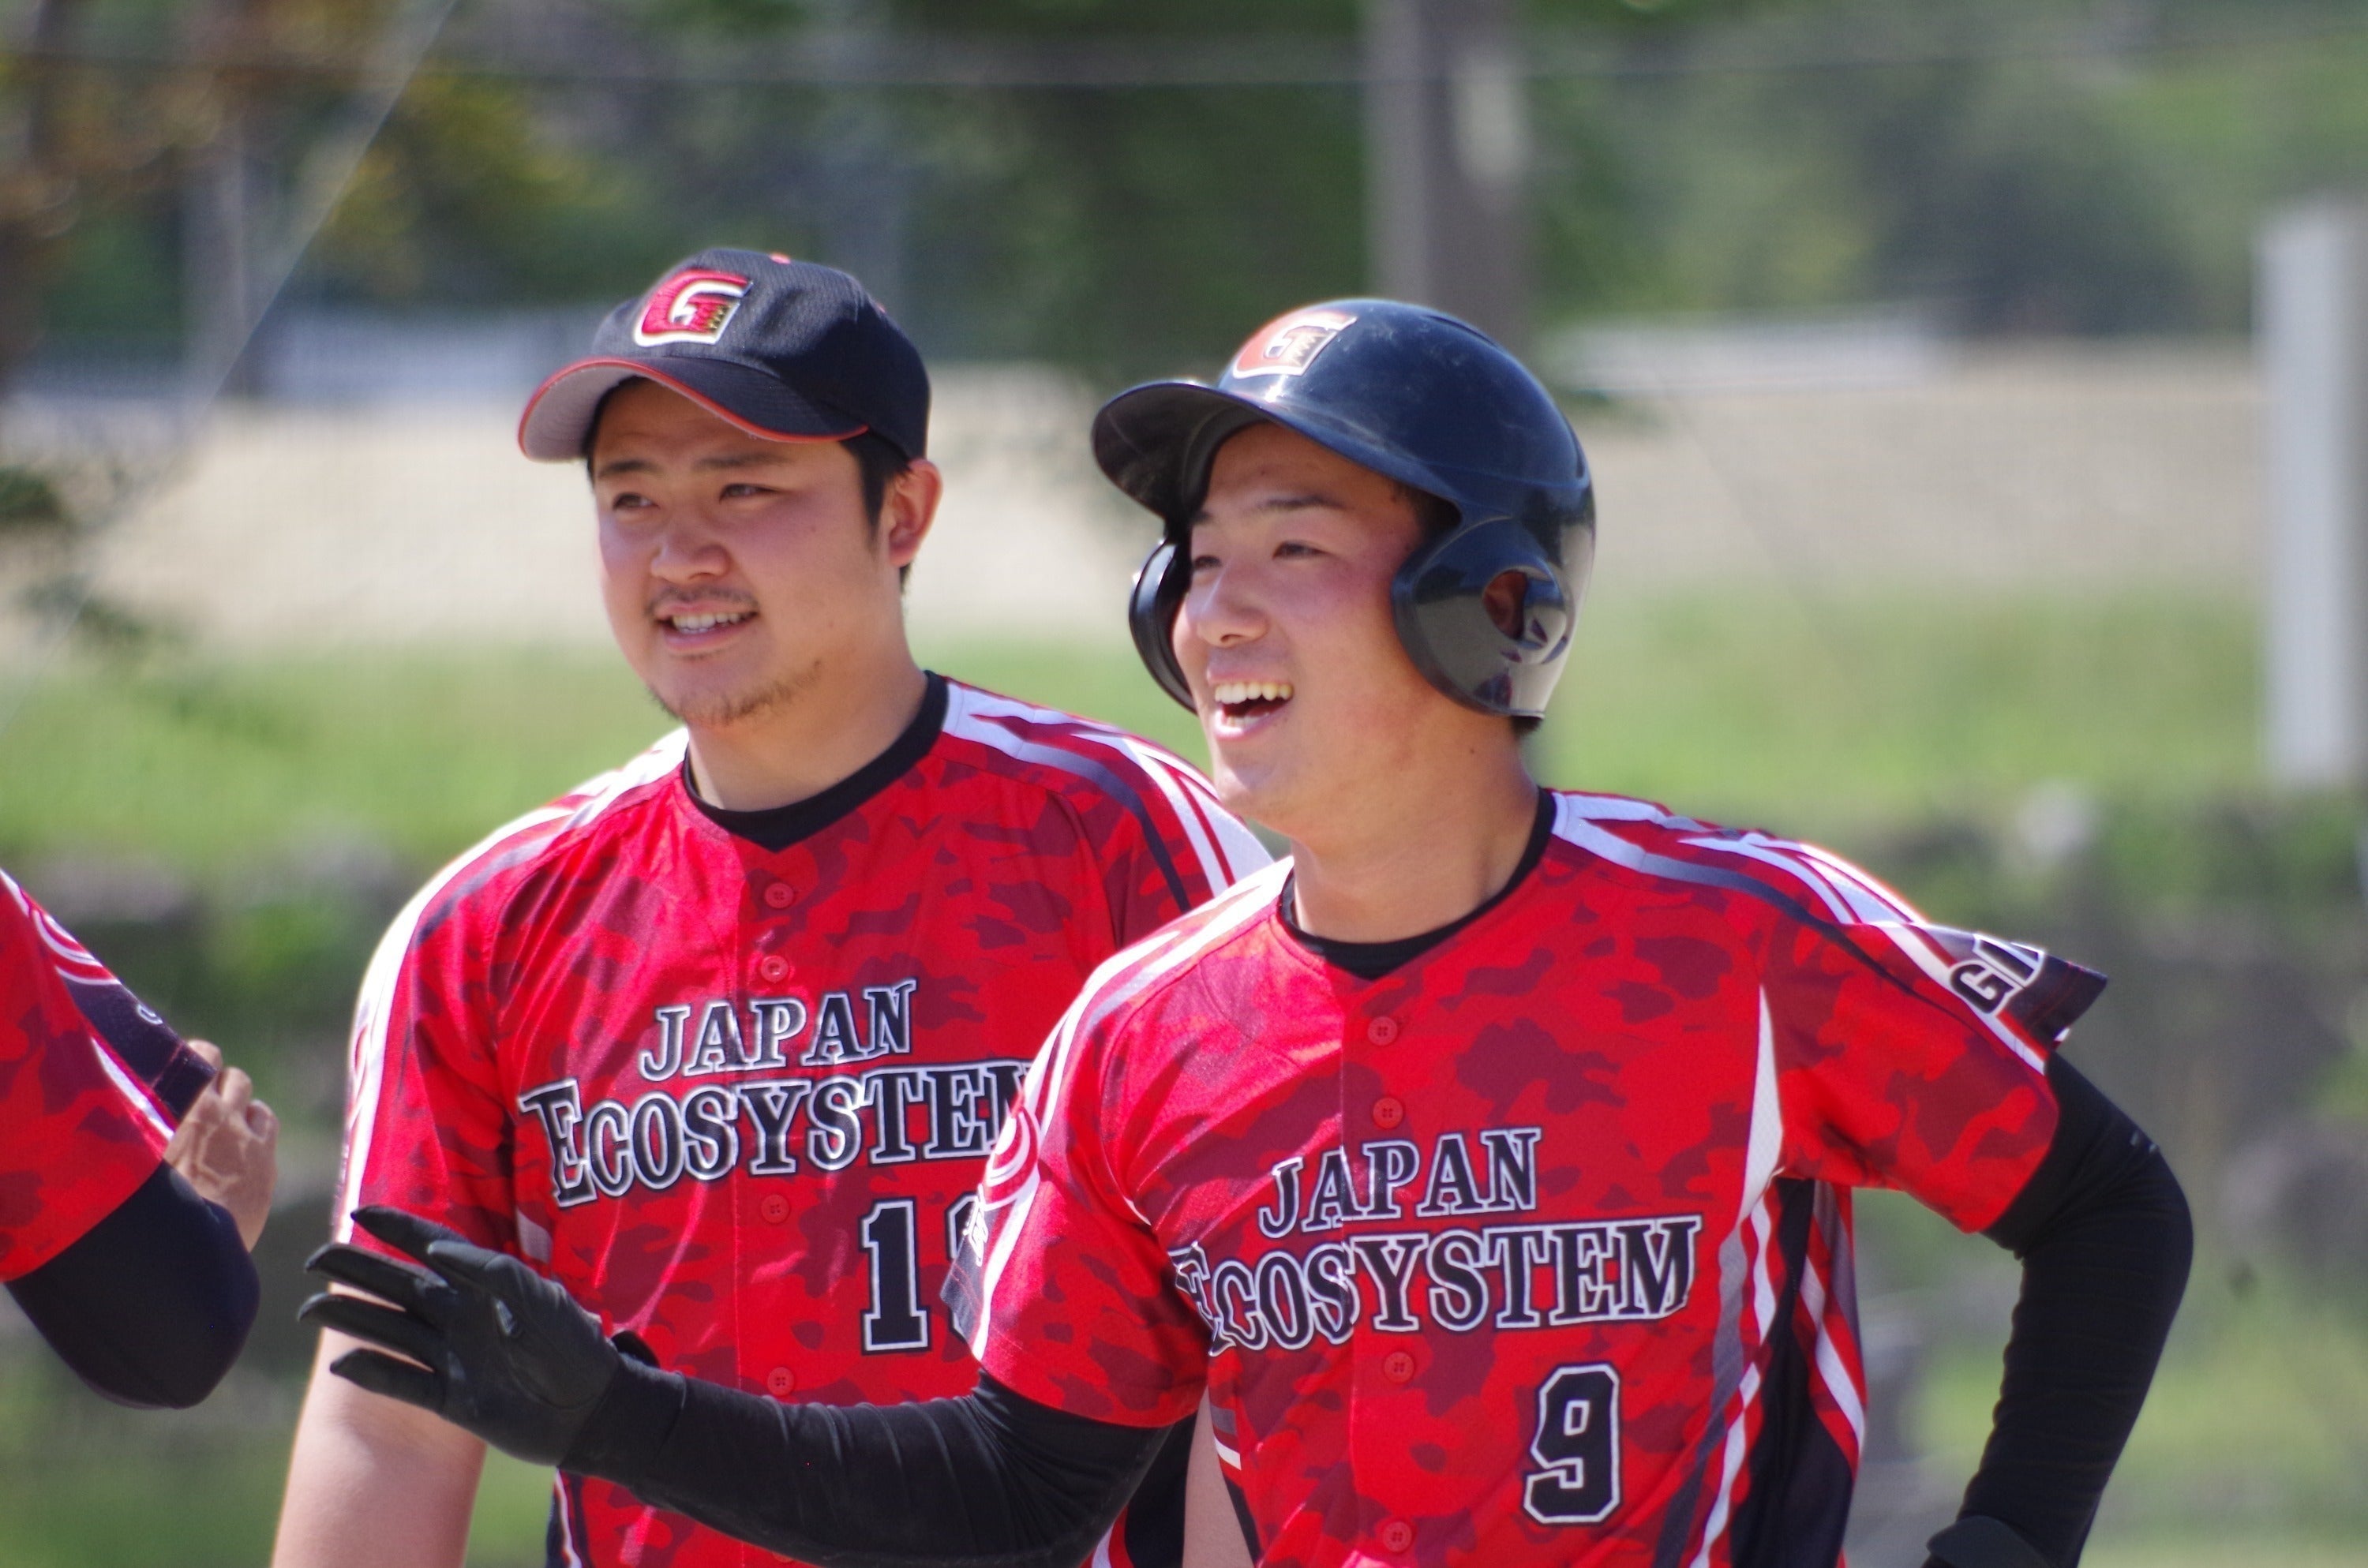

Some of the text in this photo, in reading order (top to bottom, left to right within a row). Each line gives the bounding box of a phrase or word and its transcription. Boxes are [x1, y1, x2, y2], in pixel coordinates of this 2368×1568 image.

[638, 977, 917, 1082] JAPAN
[1257, 1126, 1542, 1238] JAPAN
[1167, 1214, 1703, 1357] ECOSYSTEM
[1522, 1362, 1621, 1525] 9
